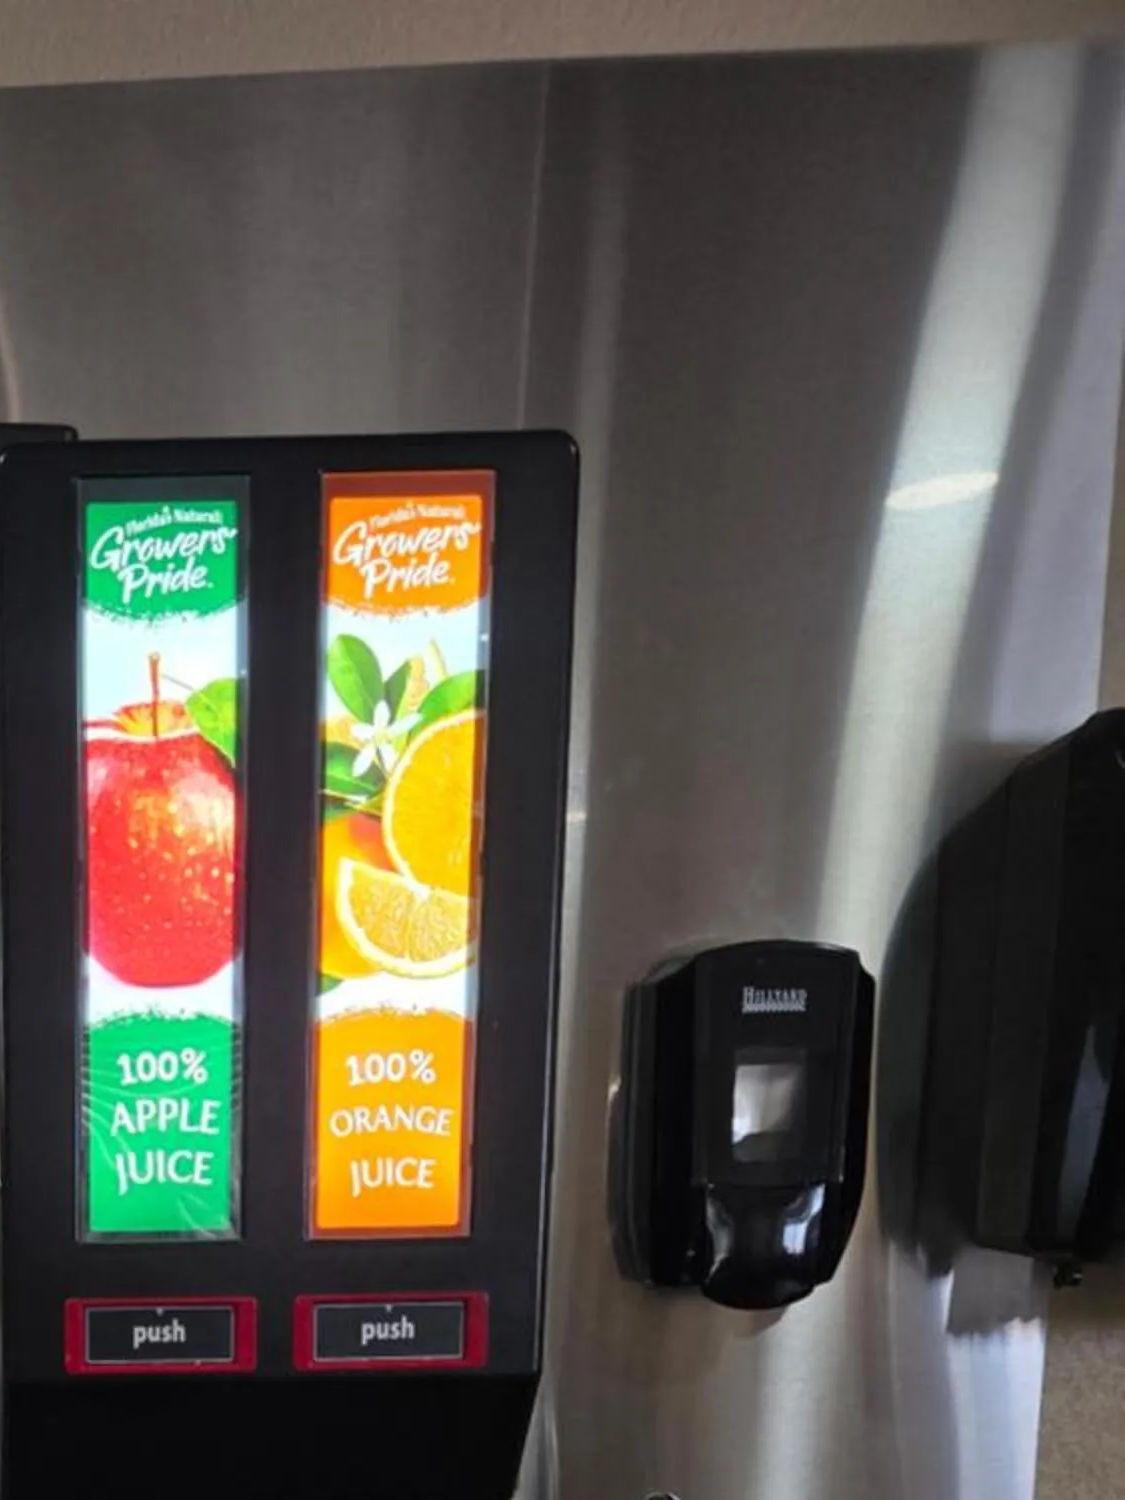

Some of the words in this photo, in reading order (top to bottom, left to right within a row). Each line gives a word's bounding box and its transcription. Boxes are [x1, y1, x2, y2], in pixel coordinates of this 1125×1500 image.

[117, 1047, 209, 1086] 100%
[345, 1049, 436, 1087] 100%
[110, 1098, 221, 1136] APPLE
[329, 1105, 455, 1138] ORANGE
[114, 1150, 215, 1196] JUICE
[349, 1157, 437, 1198] JUICE
[133, 1319, 186, 1349] push
[360, 1315, 415, 1346] push
